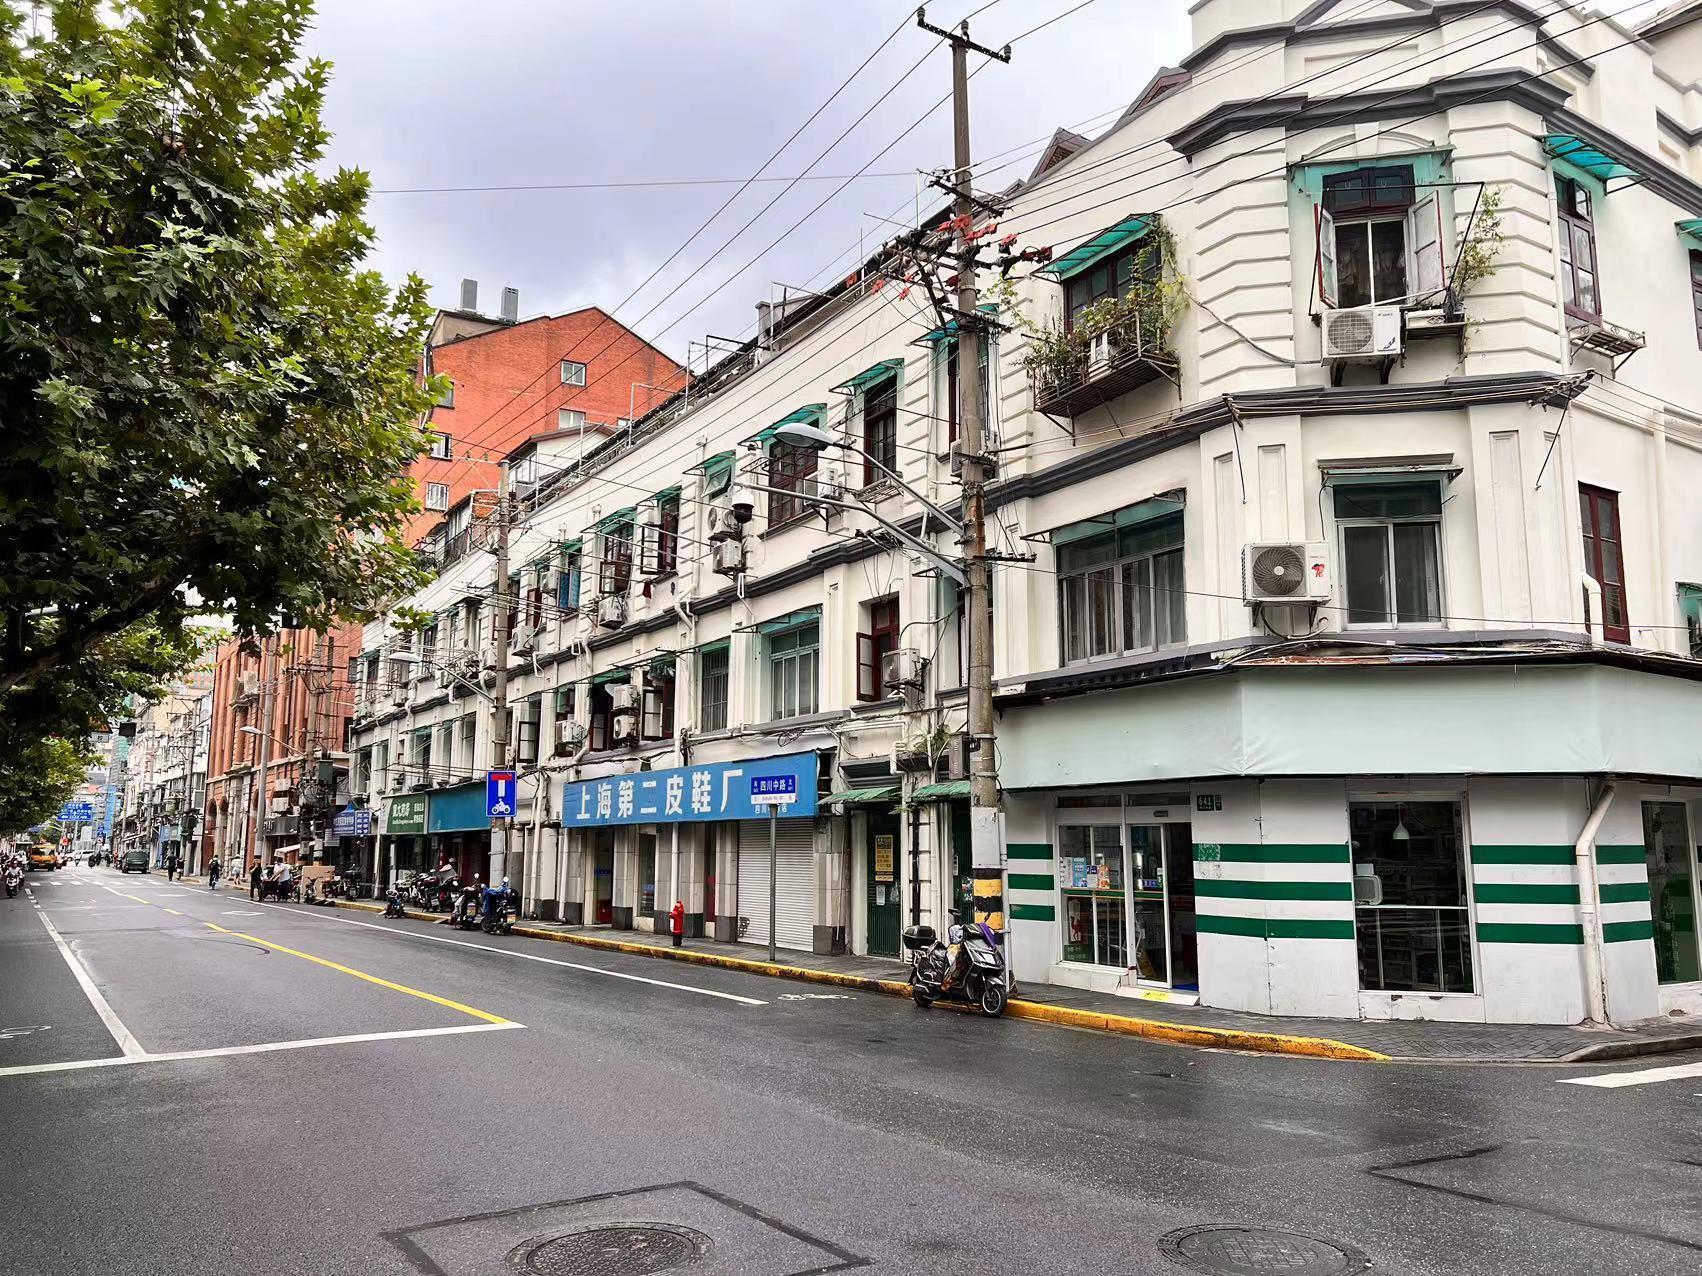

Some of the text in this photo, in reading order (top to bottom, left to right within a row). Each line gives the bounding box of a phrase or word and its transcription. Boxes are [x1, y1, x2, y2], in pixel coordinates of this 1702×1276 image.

[760, 779, 786, 792] 四川中路
[576, 769, 743, 820] 上海第二皮鞋厂
[1198, 797, 1212, 806] 641
[755, 803, 788, 814] 四川店
